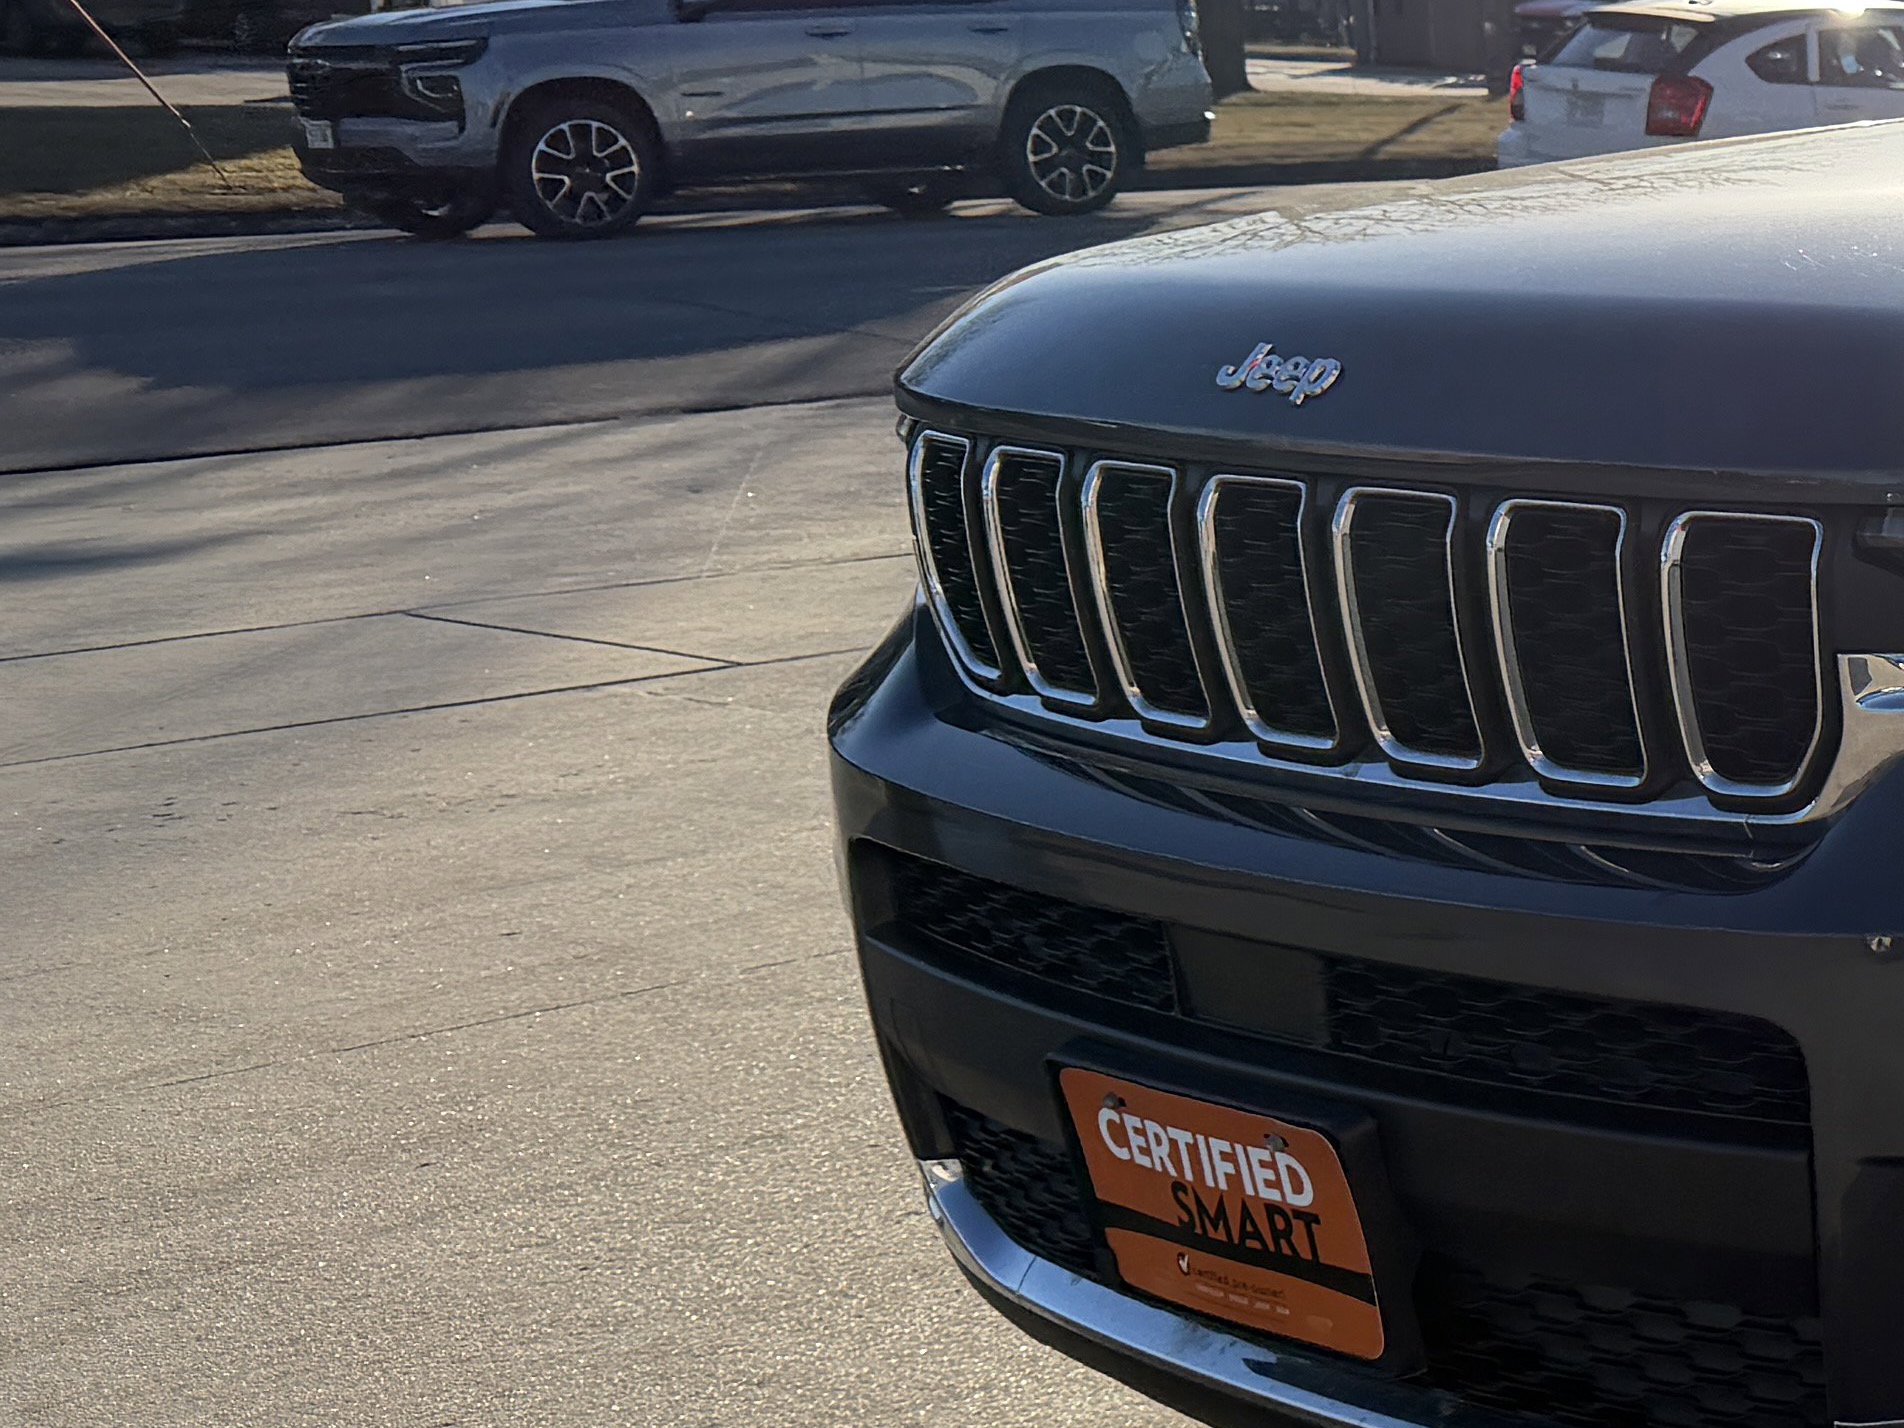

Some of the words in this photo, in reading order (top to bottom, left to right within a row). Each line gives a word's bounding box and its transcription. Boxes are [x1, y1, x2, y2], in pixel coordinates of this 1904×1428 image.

[1216, 342, 1342, 405] Jeep
[1098, 1107, 1314, 1207] CERTIFIED
[1170, 1180, 1321, 1264] SMART
